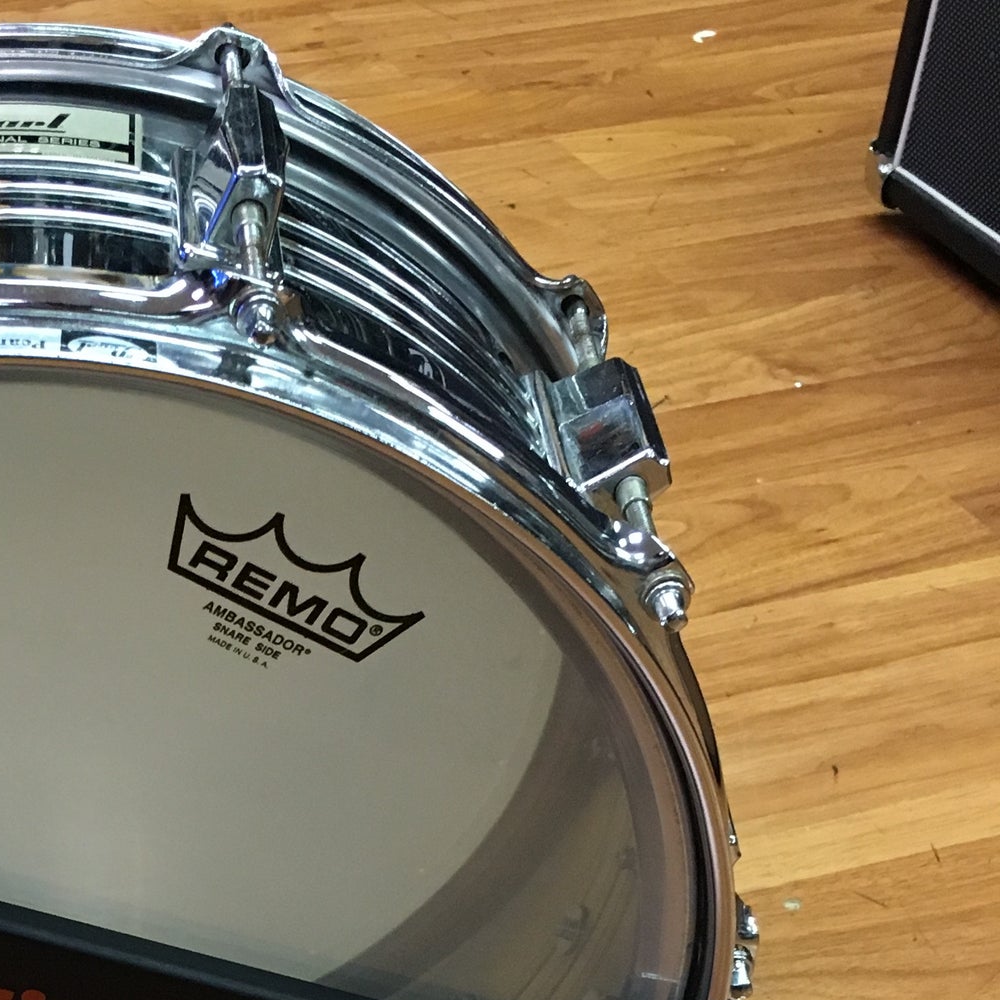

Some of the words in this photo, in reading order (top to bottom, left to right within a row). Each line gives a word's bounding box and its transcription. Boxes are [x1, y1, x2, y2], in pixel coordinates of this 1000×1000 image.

[38, 136, 101, 148] SERIES
[207, 634, 233, 651] MADE
[233, 646, 244, 656] IN
[212, 622, 252, 646] SNARE
[254, 642, 282, 660] SIDE
